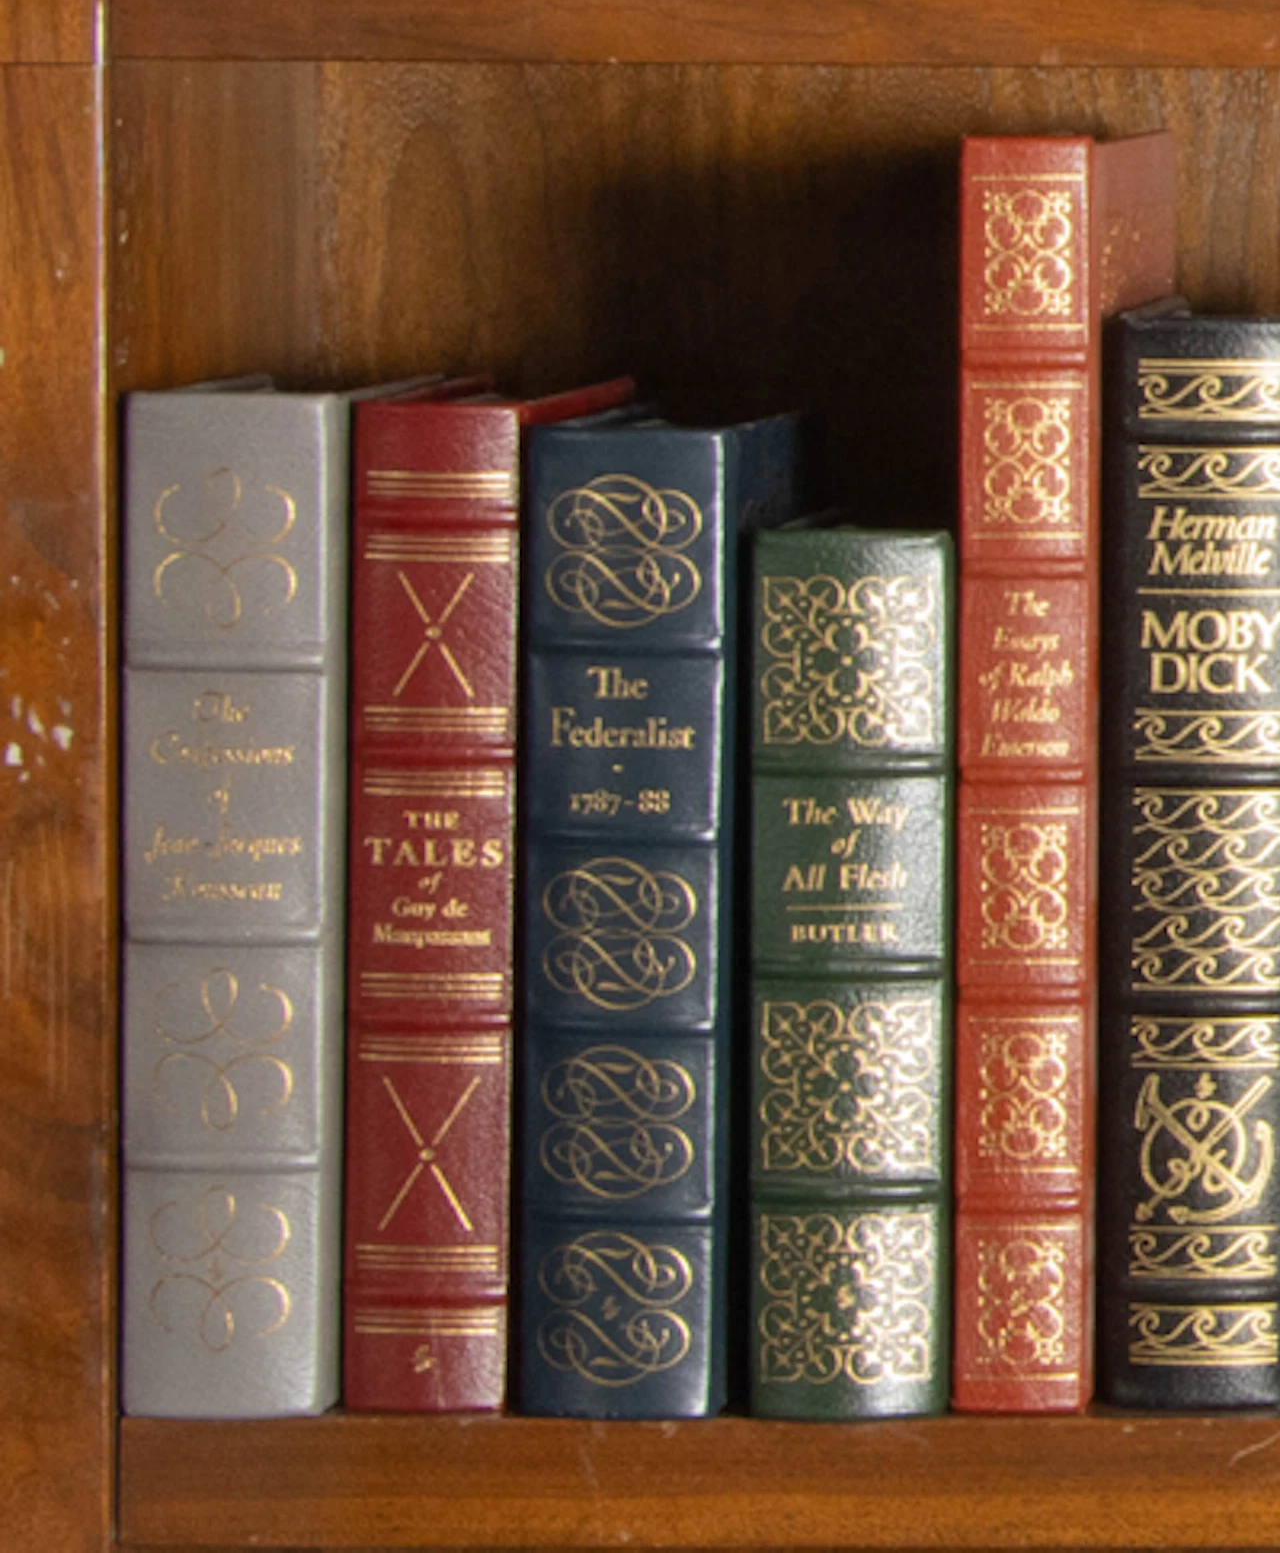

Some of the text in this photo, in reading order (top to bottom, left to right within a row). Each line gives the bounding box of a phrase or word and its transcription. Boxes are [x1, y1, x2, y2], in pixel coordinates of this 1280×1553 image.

[1146, 506, 1279, 542] Herman
[1147, 541, 1272, 577] Melville
[1004, 589, 1051, 619] The
[587, 665, 649, 700] The
[1009, 656, 1075, 696] Ralph
[1149, 651, 1273, 695] DICK
[550, 707, 696, 750] Federalist
[402, 809, 461, 830] THE
[782, 796, 911, 830] The Way
[364, 837, 504, 869] TALES
[830, 828, 861, 859] of
[417, 870, 444, 895] of
[781, 863, 910, 893] All Flesh
[391, 897, 469, 922] Guy de
[372, 923, 492, 948] Maupassant
[789, 922, 902, 945] BUTLER
